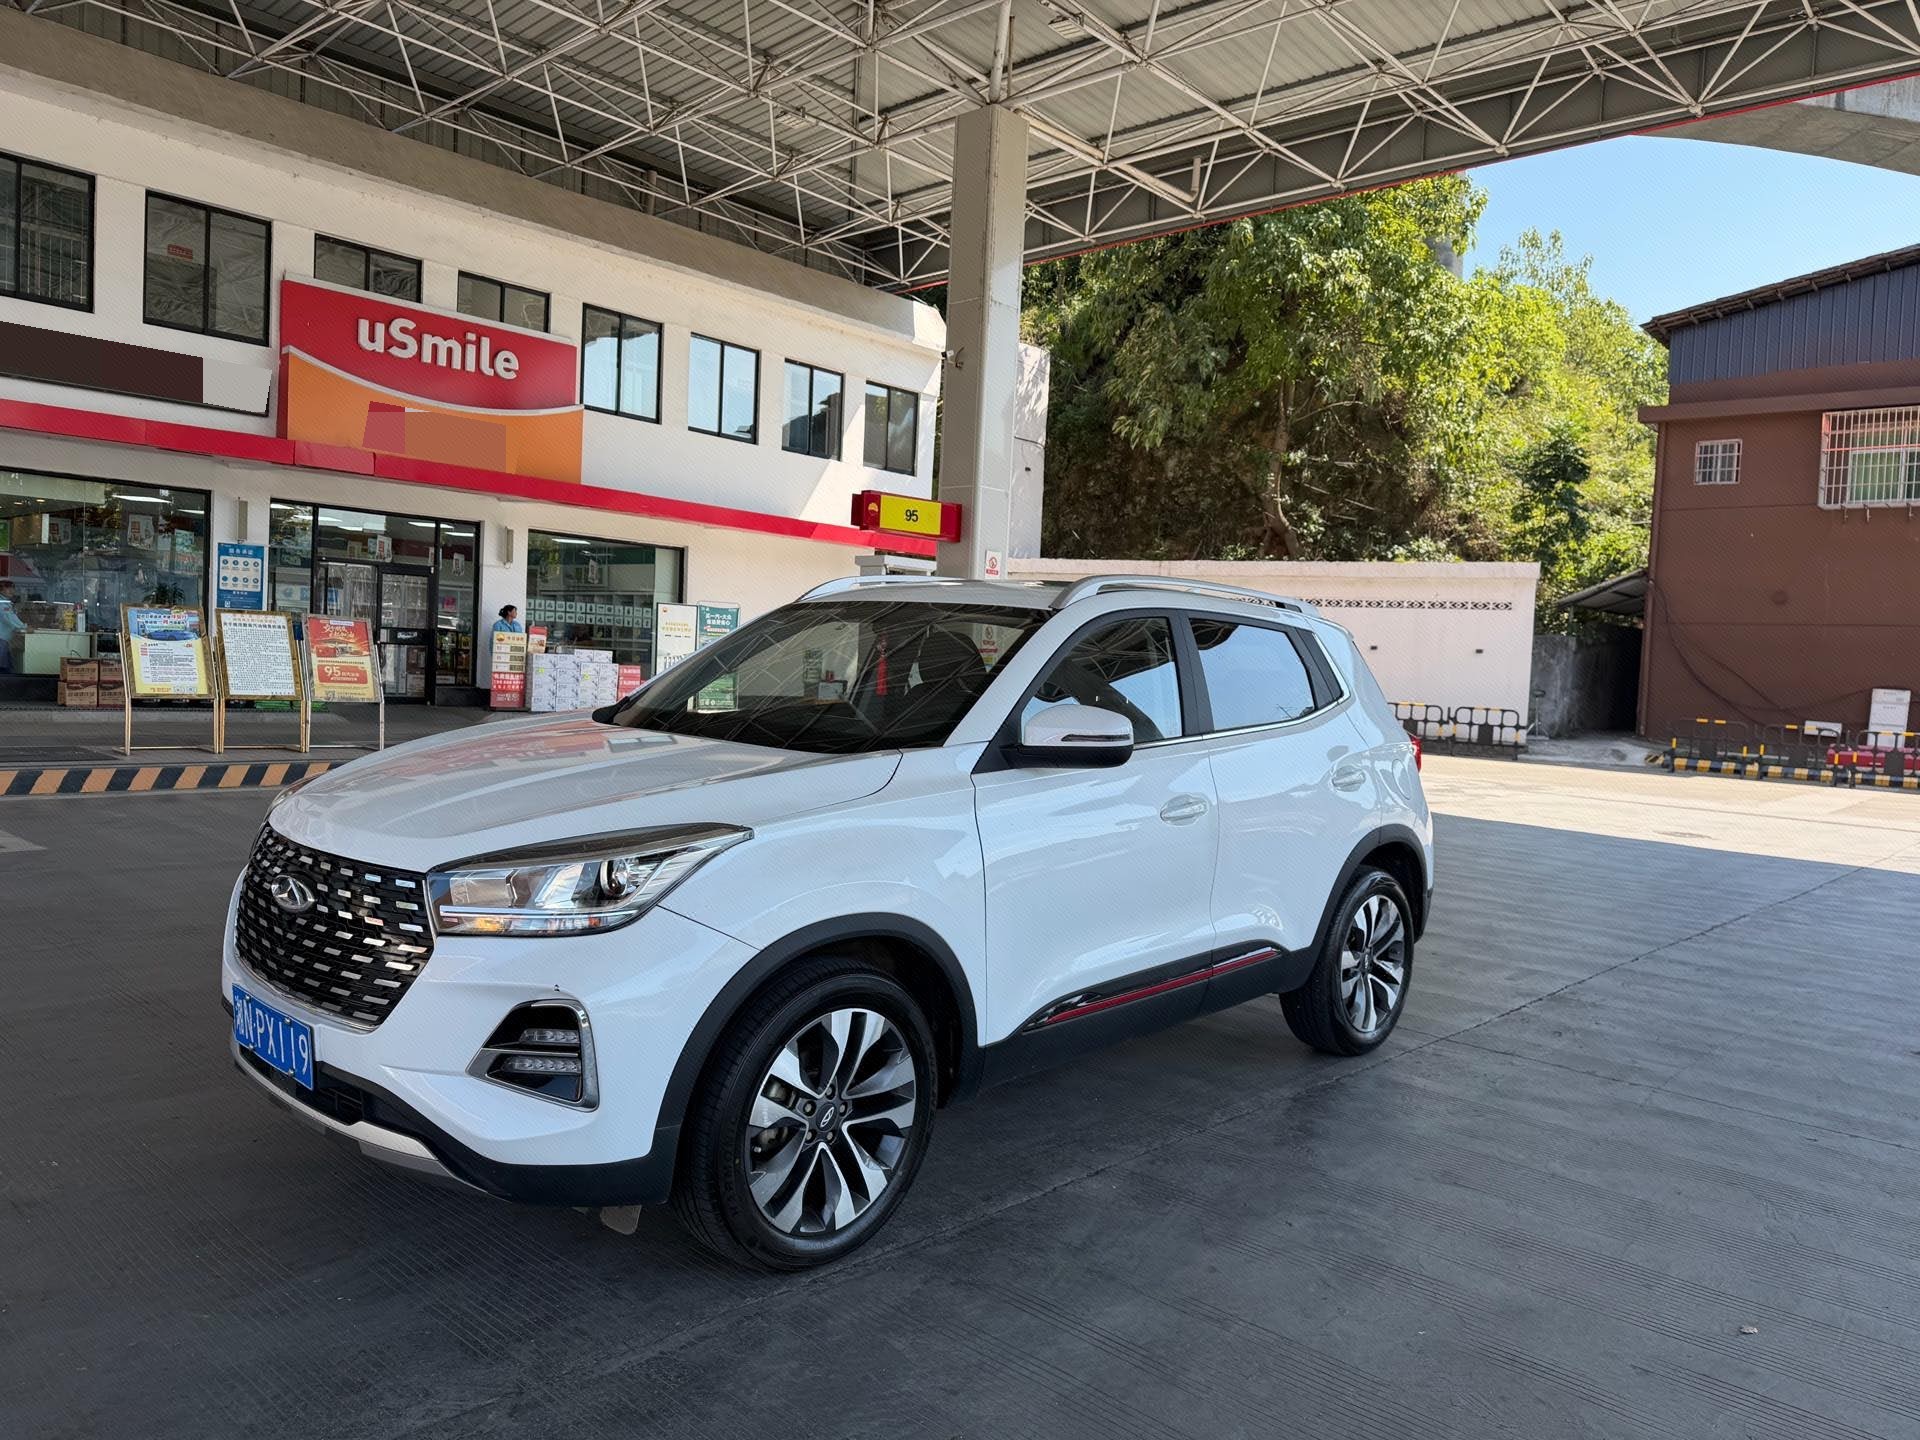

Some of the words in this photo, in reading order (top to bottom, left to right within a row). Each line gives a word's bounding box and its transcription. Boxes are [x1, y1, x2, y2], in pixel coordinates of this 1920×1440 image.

[357, 317, 520, 380] uSmile
[905, 508, 919, 523] 95
[324, 666, 342, 677] 95
